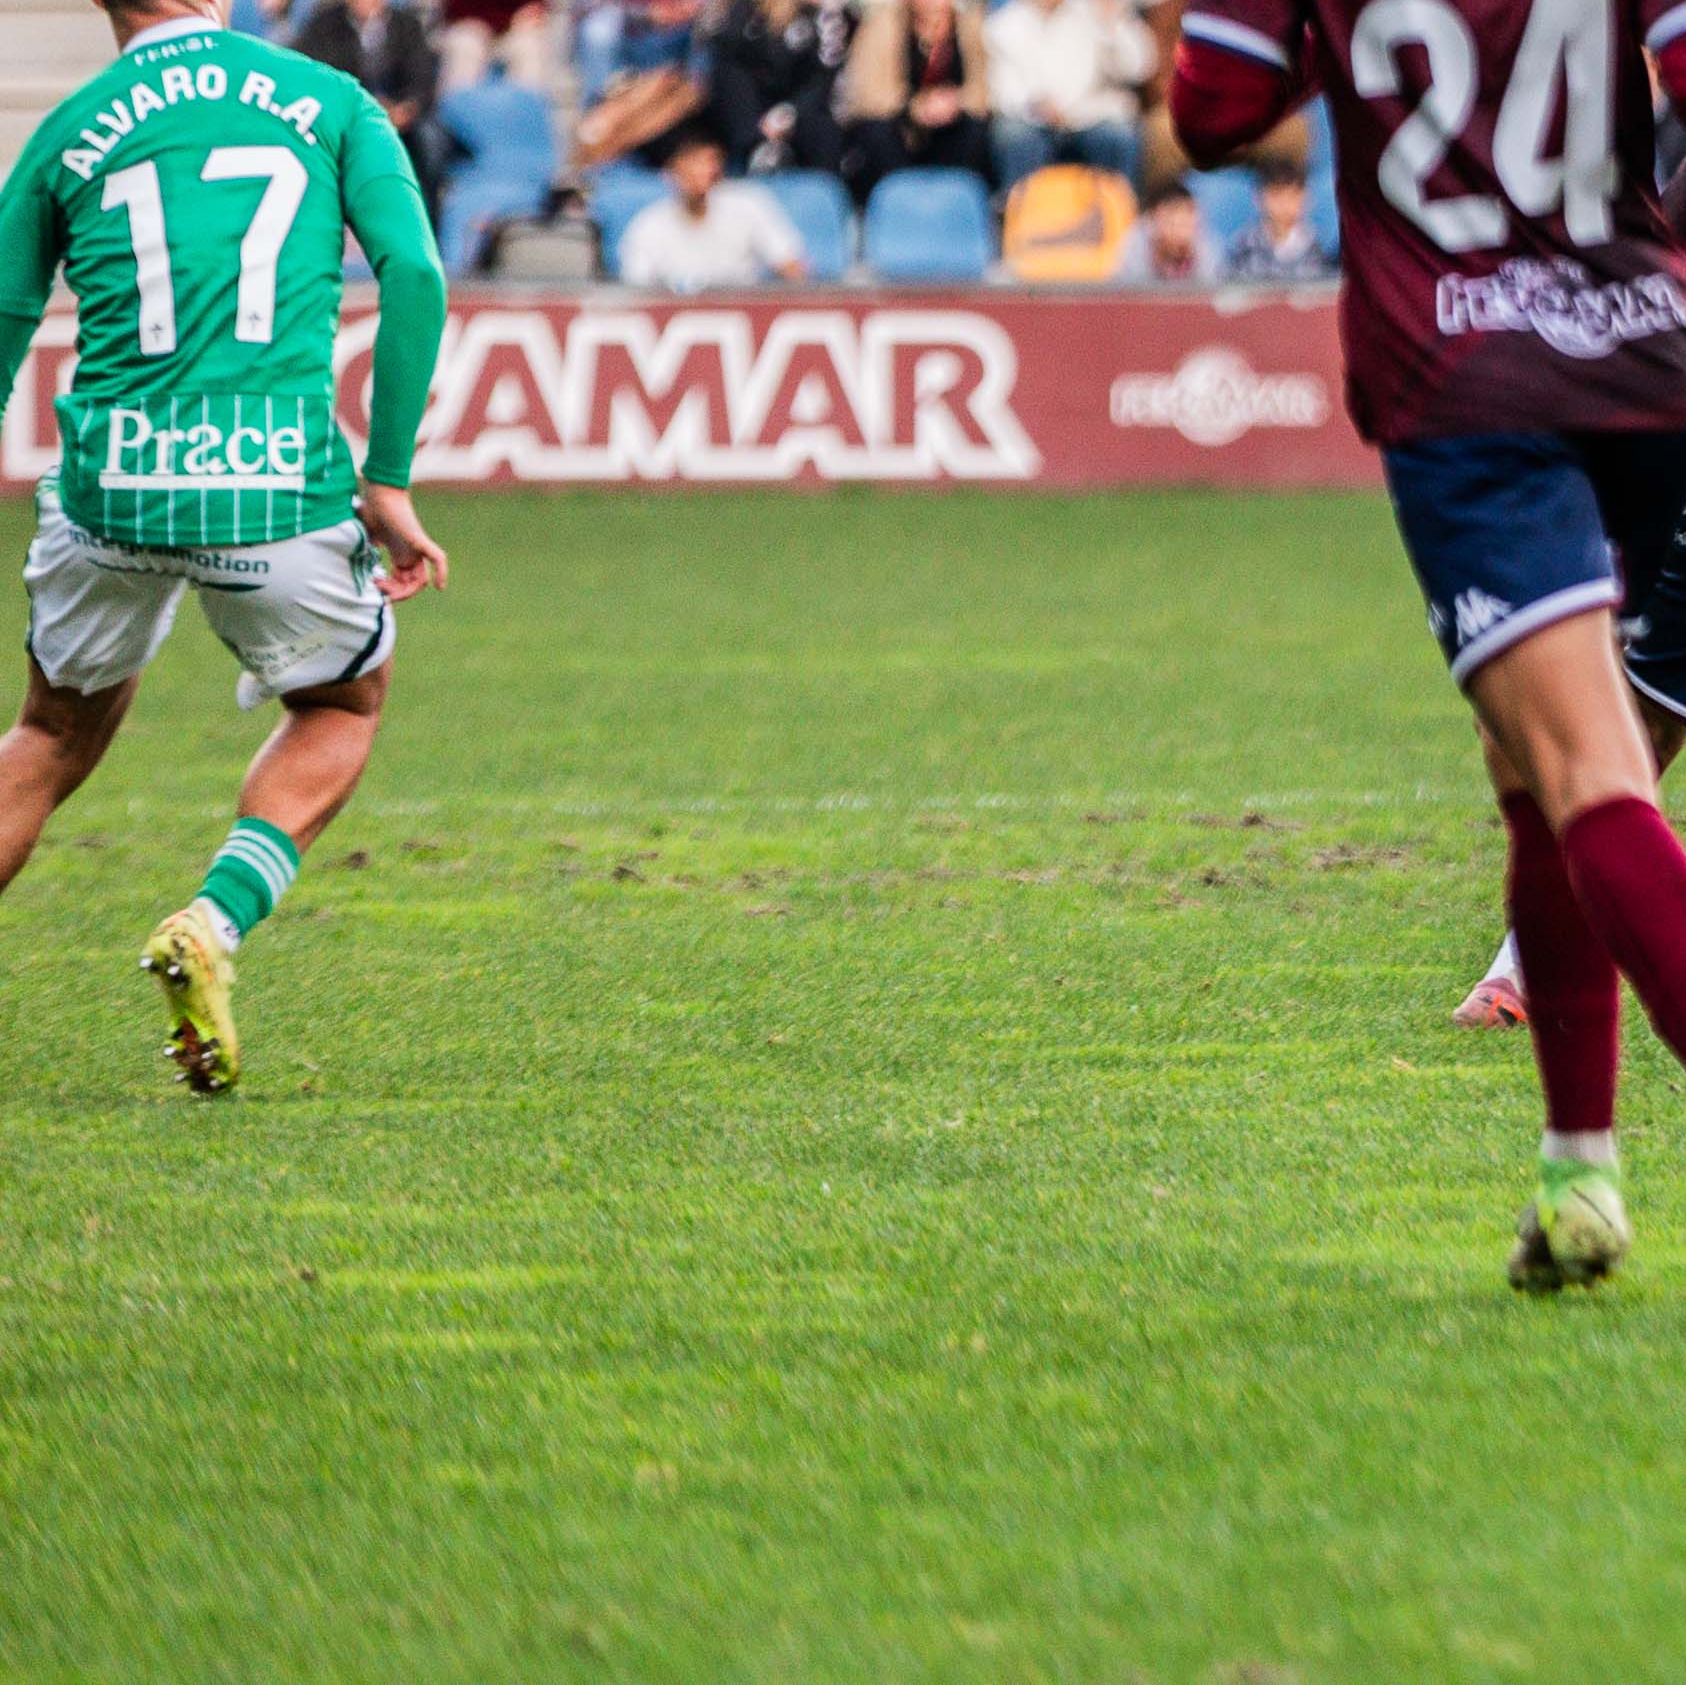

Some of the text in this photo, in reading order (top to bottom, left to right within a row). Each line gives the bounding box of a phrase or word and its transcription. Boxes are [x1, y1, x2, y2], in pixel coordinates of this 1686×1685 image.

[62, 64, 322, 182] ALVARO R.A.
[102, 145, 308, 356] 17
[101, 409, 307, 474] Prace
